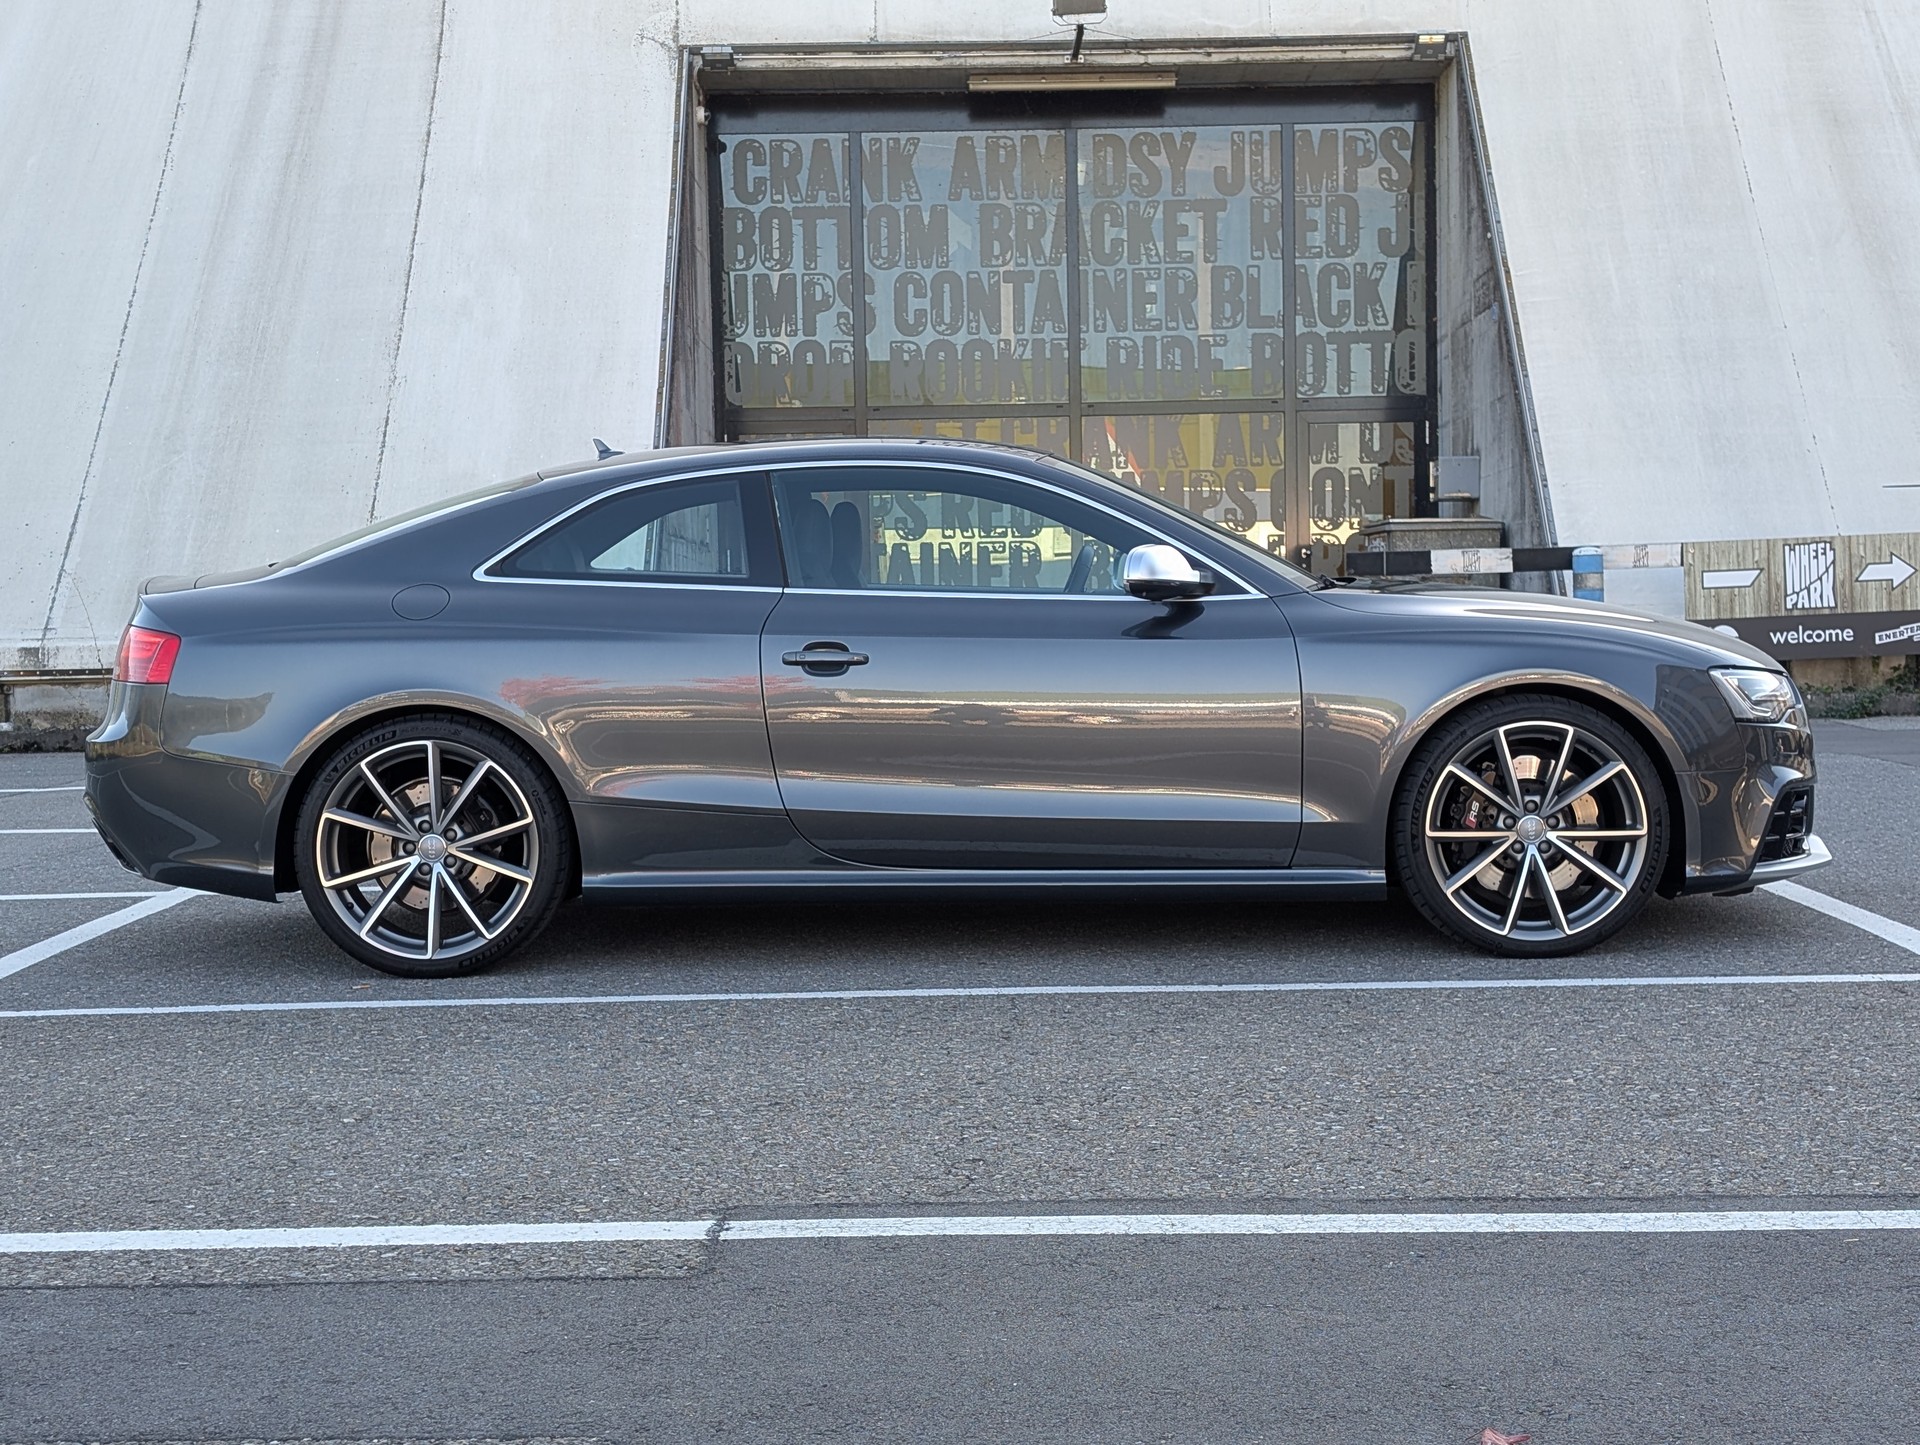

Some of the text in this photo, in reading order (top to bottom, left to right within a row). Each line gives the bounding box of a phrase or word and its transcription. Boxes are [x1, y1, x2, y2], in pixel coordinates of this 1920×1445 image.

[732, 126, 1413, 205] CRANK ARM DSY JUMPS
[723, 203, 949, 271] BOTTOM
[979, 197, 1228, 268] BRACKET
[1250, 193, 1361, 261] RED
[894, 266, 1199, 337] CONTAINER
[1211, 262, 1388, 330] BLACK
[890, 338, 1088, 404] ROOKIE
[1106, 335, 1228, 401] RIDE
[1783, 541, 1835, 596] WHEEL
[1785, 562, 1836, 610] PARK
[1769, 624, 1855, 645] welcome
[336, 730, 394, 772] MICHELIN
[1469, 800, 1480, 823] RS
